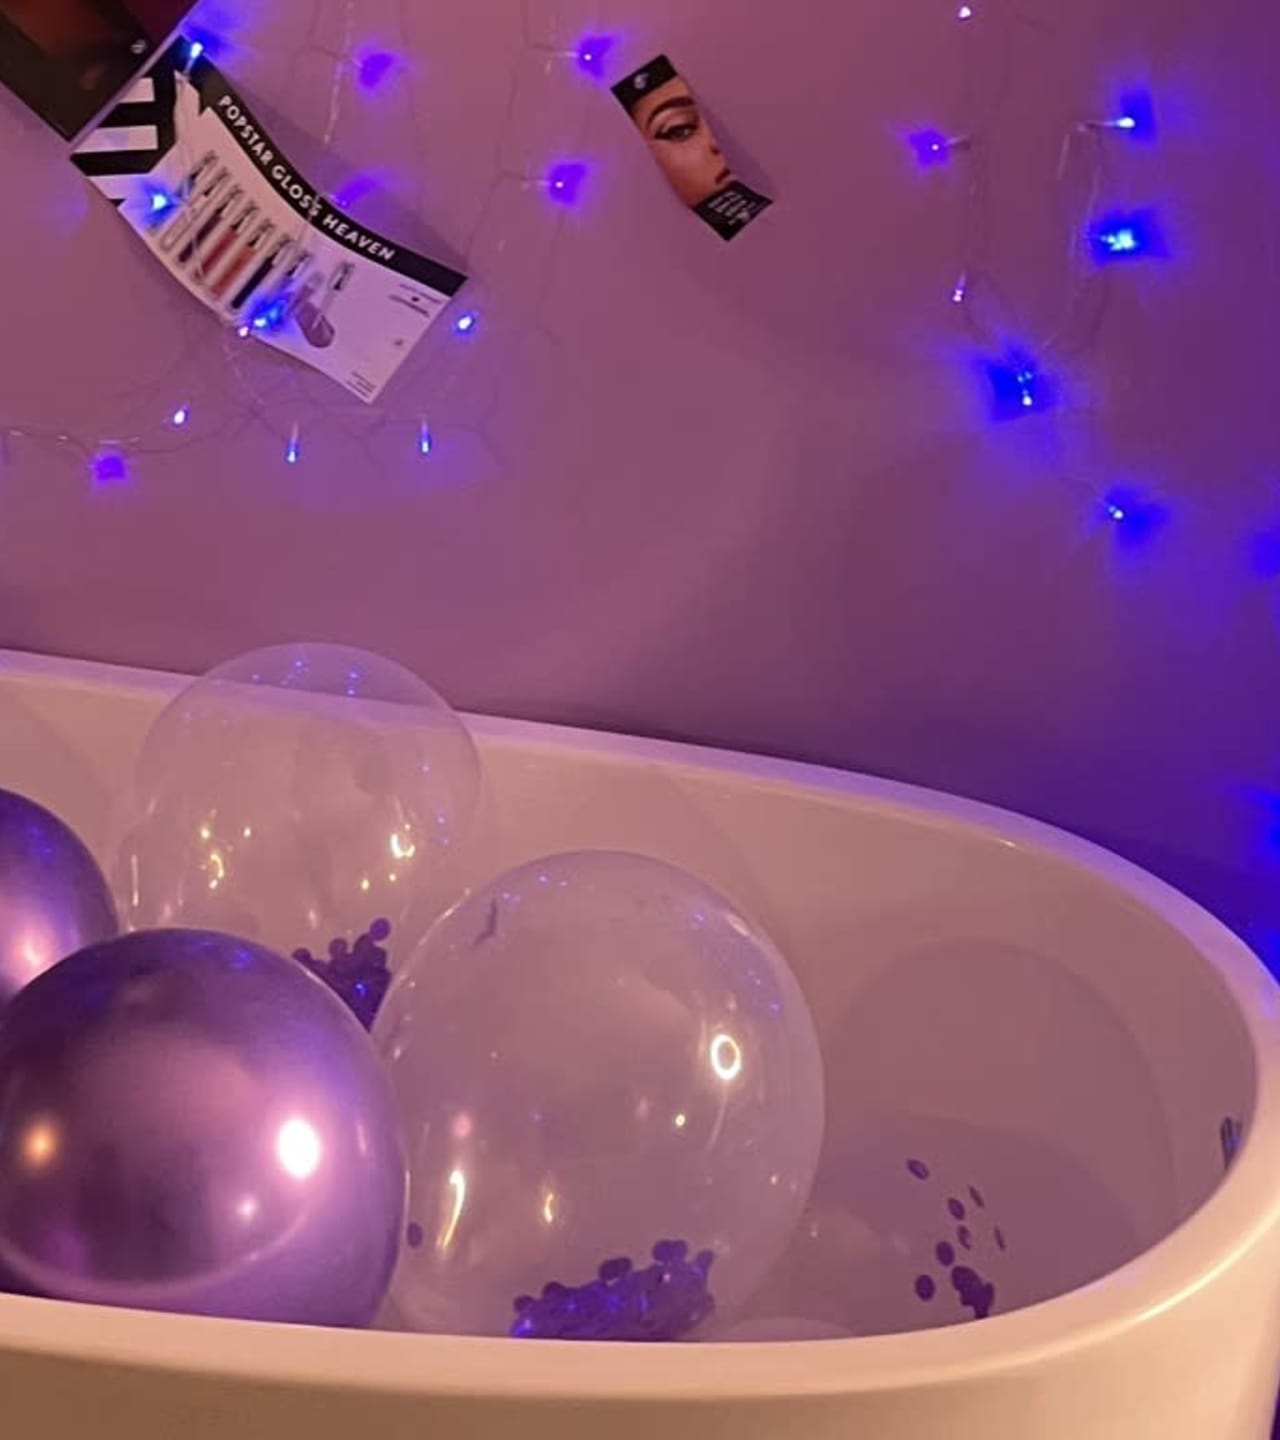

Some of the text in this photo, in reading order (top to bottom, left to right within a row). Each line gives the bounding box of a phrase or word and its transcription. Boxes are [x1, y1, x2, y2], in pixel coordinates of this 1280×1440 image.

[218, 95, 395, 261] POPSTAR GLOSS HEAVEN
